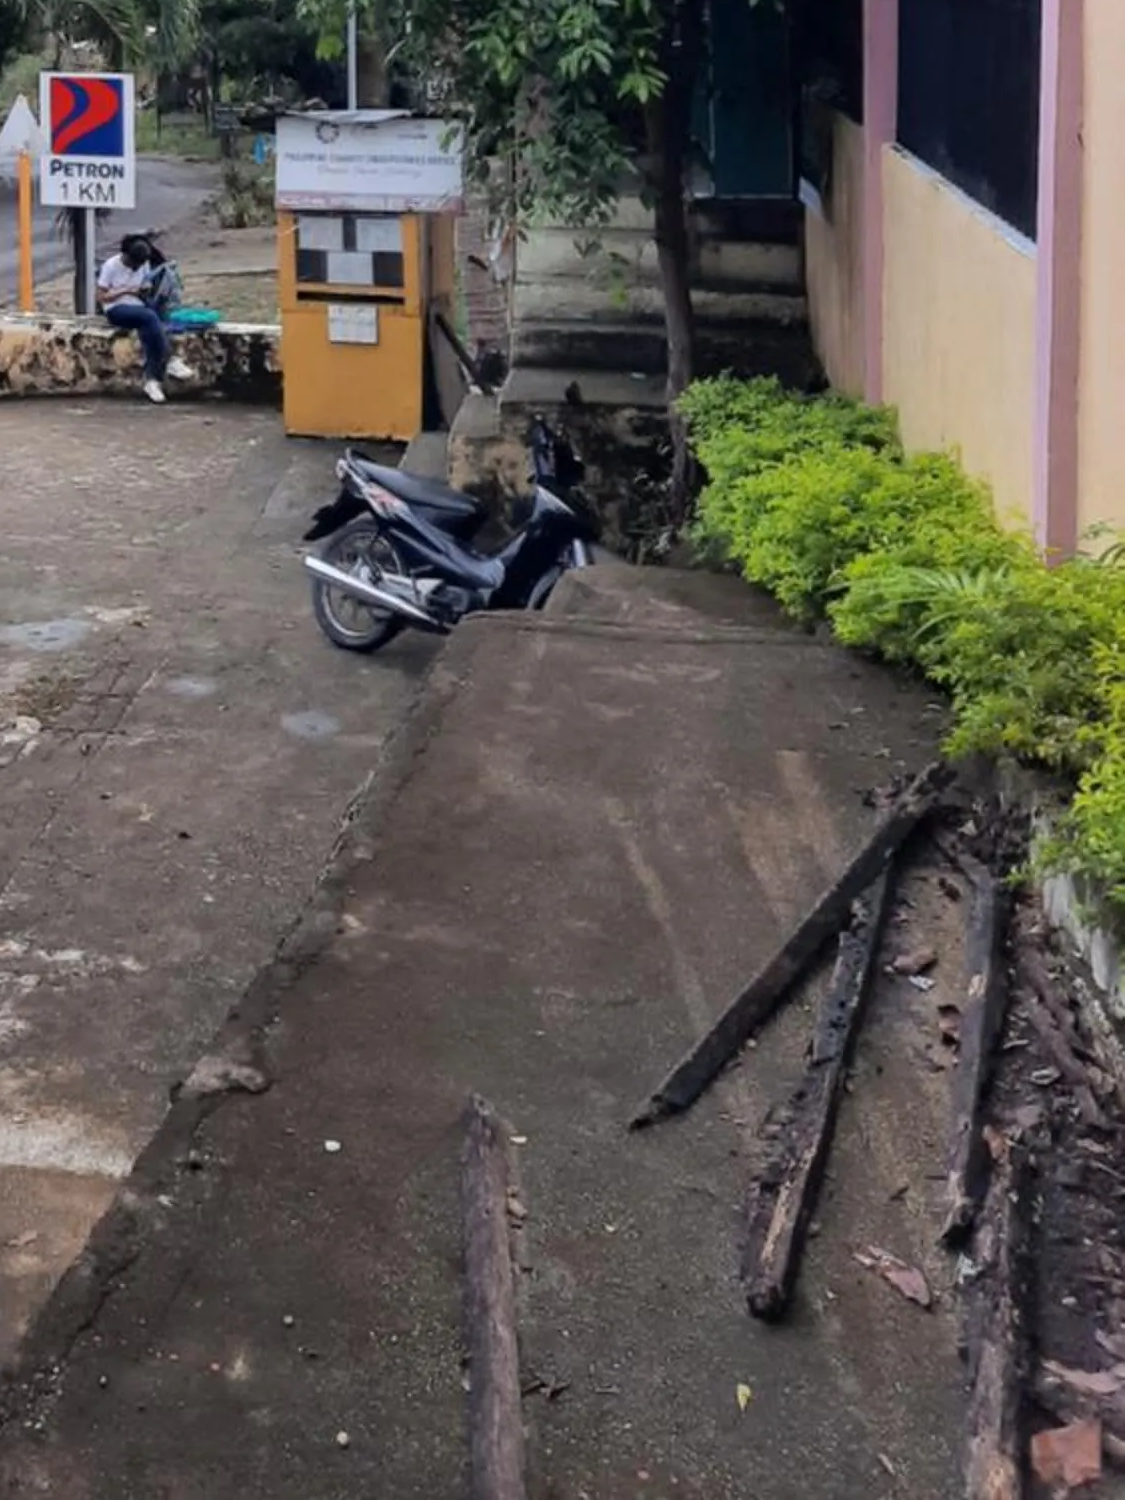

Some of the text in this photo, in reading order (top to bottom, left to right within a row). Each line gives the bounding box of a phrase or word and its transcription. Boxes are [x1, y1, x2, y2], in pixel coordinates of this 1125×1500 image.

[50, 159, 124, 178] PETRON
[60, 182, 116, 203] 1 KM
